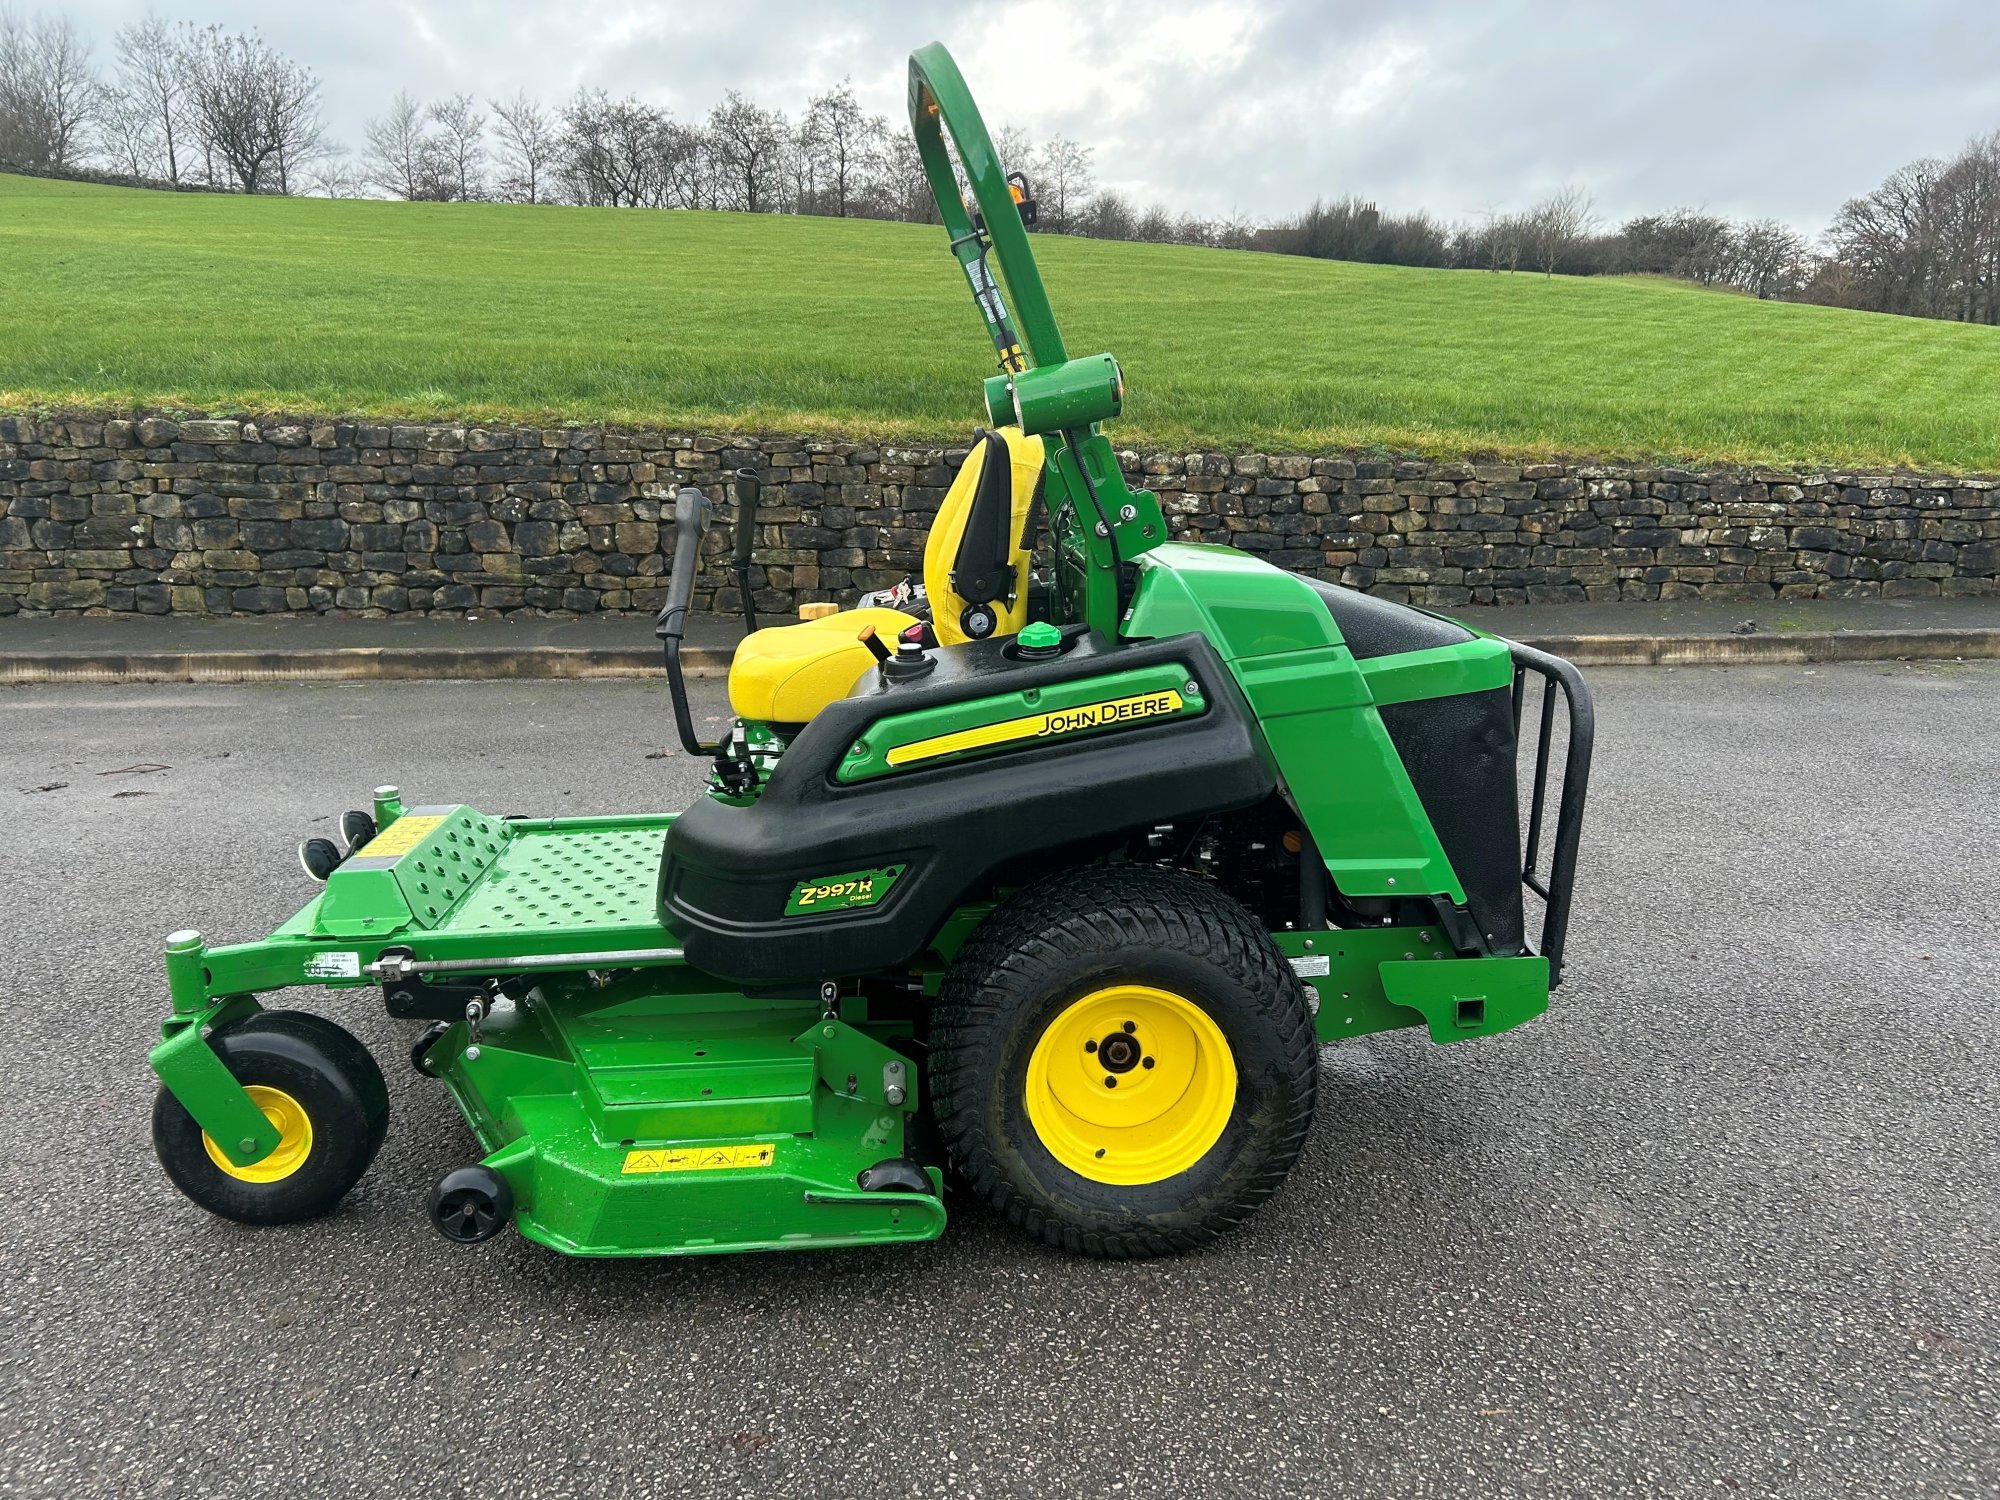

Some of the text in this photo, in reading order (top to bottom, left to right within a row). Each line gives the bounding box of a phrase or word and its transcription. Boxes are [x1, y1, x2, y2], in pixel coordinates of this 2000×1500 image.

[1038, 697, 1170, 734] JOHN DEERE
[798, 880, 873, 906] Z997R
[849, 894, 872, 902] Diesel
